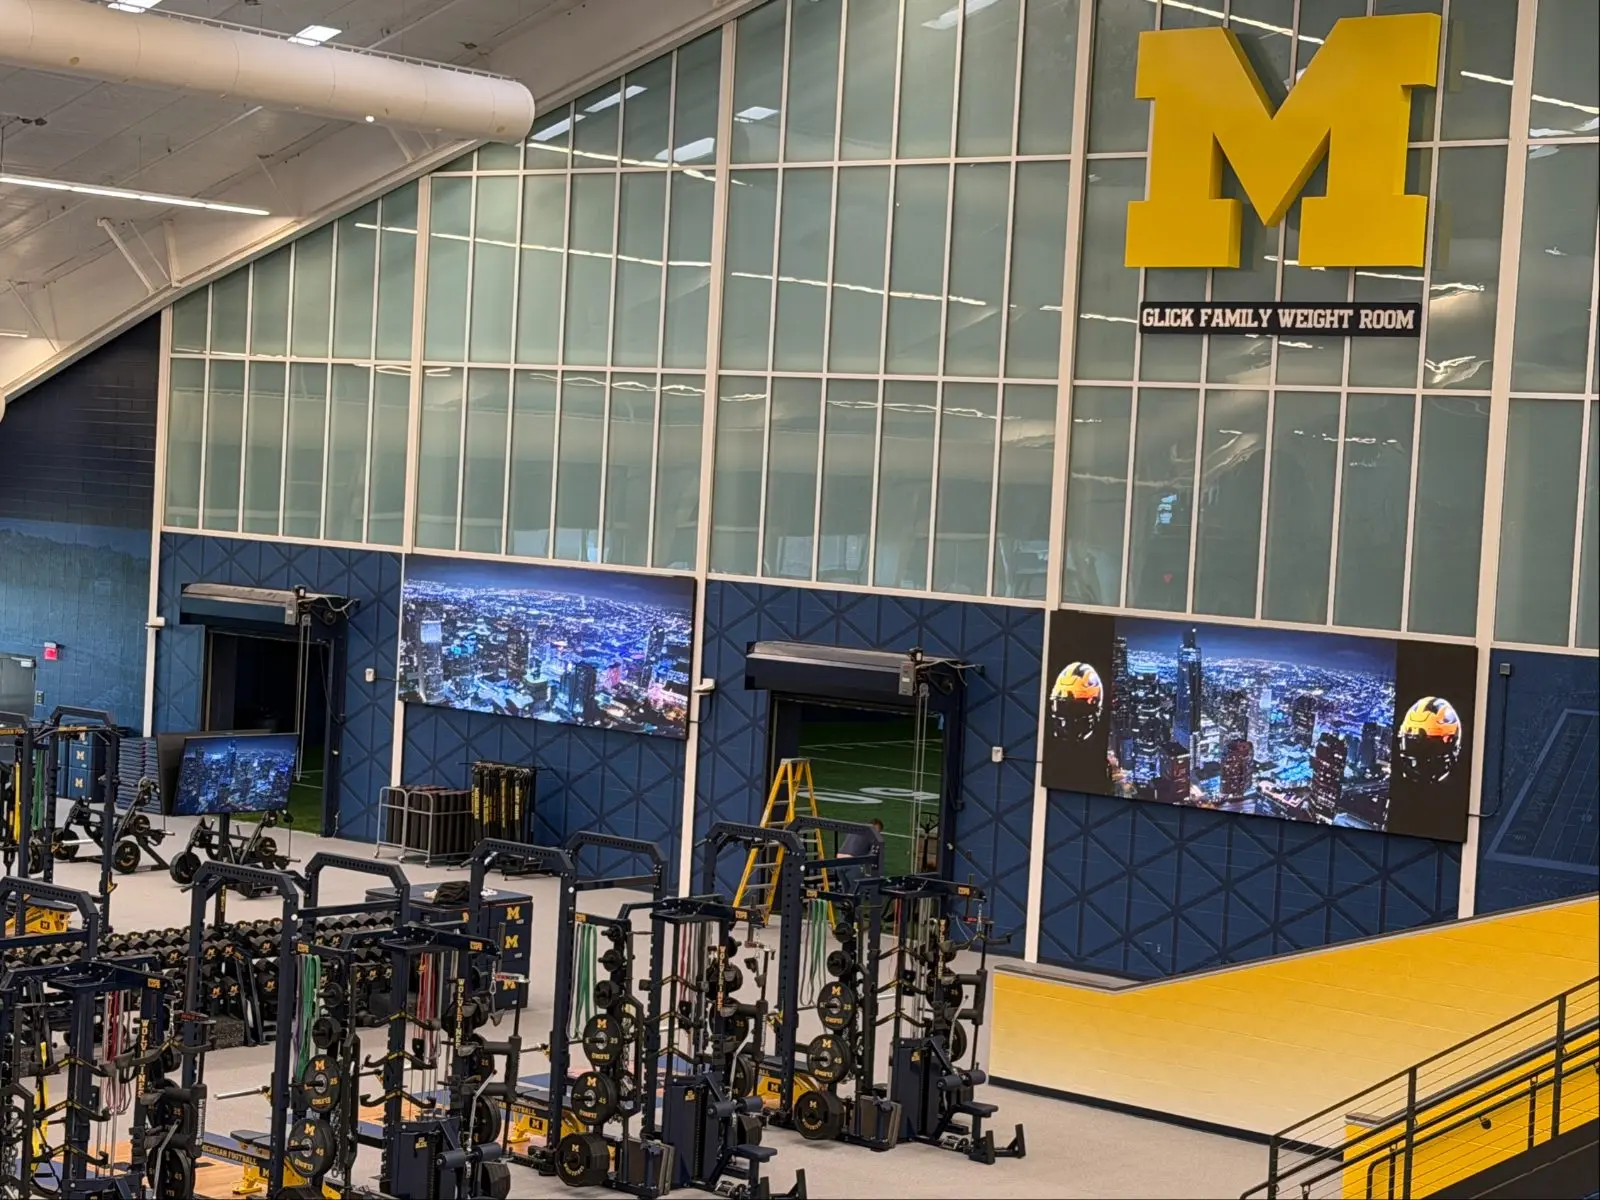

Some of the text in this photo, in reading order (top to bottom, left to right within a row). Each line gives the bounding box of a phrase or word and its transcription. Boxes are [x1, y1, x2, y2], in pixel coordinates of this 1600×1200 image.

[1124, 13, 1441, 268] M
[1142, 307, 1415, 330] GLICK FAMILY WEIGHT ROOM
[76, 750, 85, 761] M
[75, 778, 84, 788] M
[506, 906, 520, 920] M
[505, 935, 519, 949] M
[503, 980, 516, 991] M
[832, 986, 842, 996] M
[455, 978, 466, 1050] WOLVERINES
[596, 1018, 607, 1029] M
[822, 1038, 833, 1049] M
[315, 1060, 325, 1071] M
[586, 1076, 597, 1087] M
[809, 1101, 817, 1109] M
[532, 1119, 540, 1128] M
[304, 1123, 316, 1136] M
[572, 1144, 580, 1153] M
[262, 1168, 270, 1178] M
